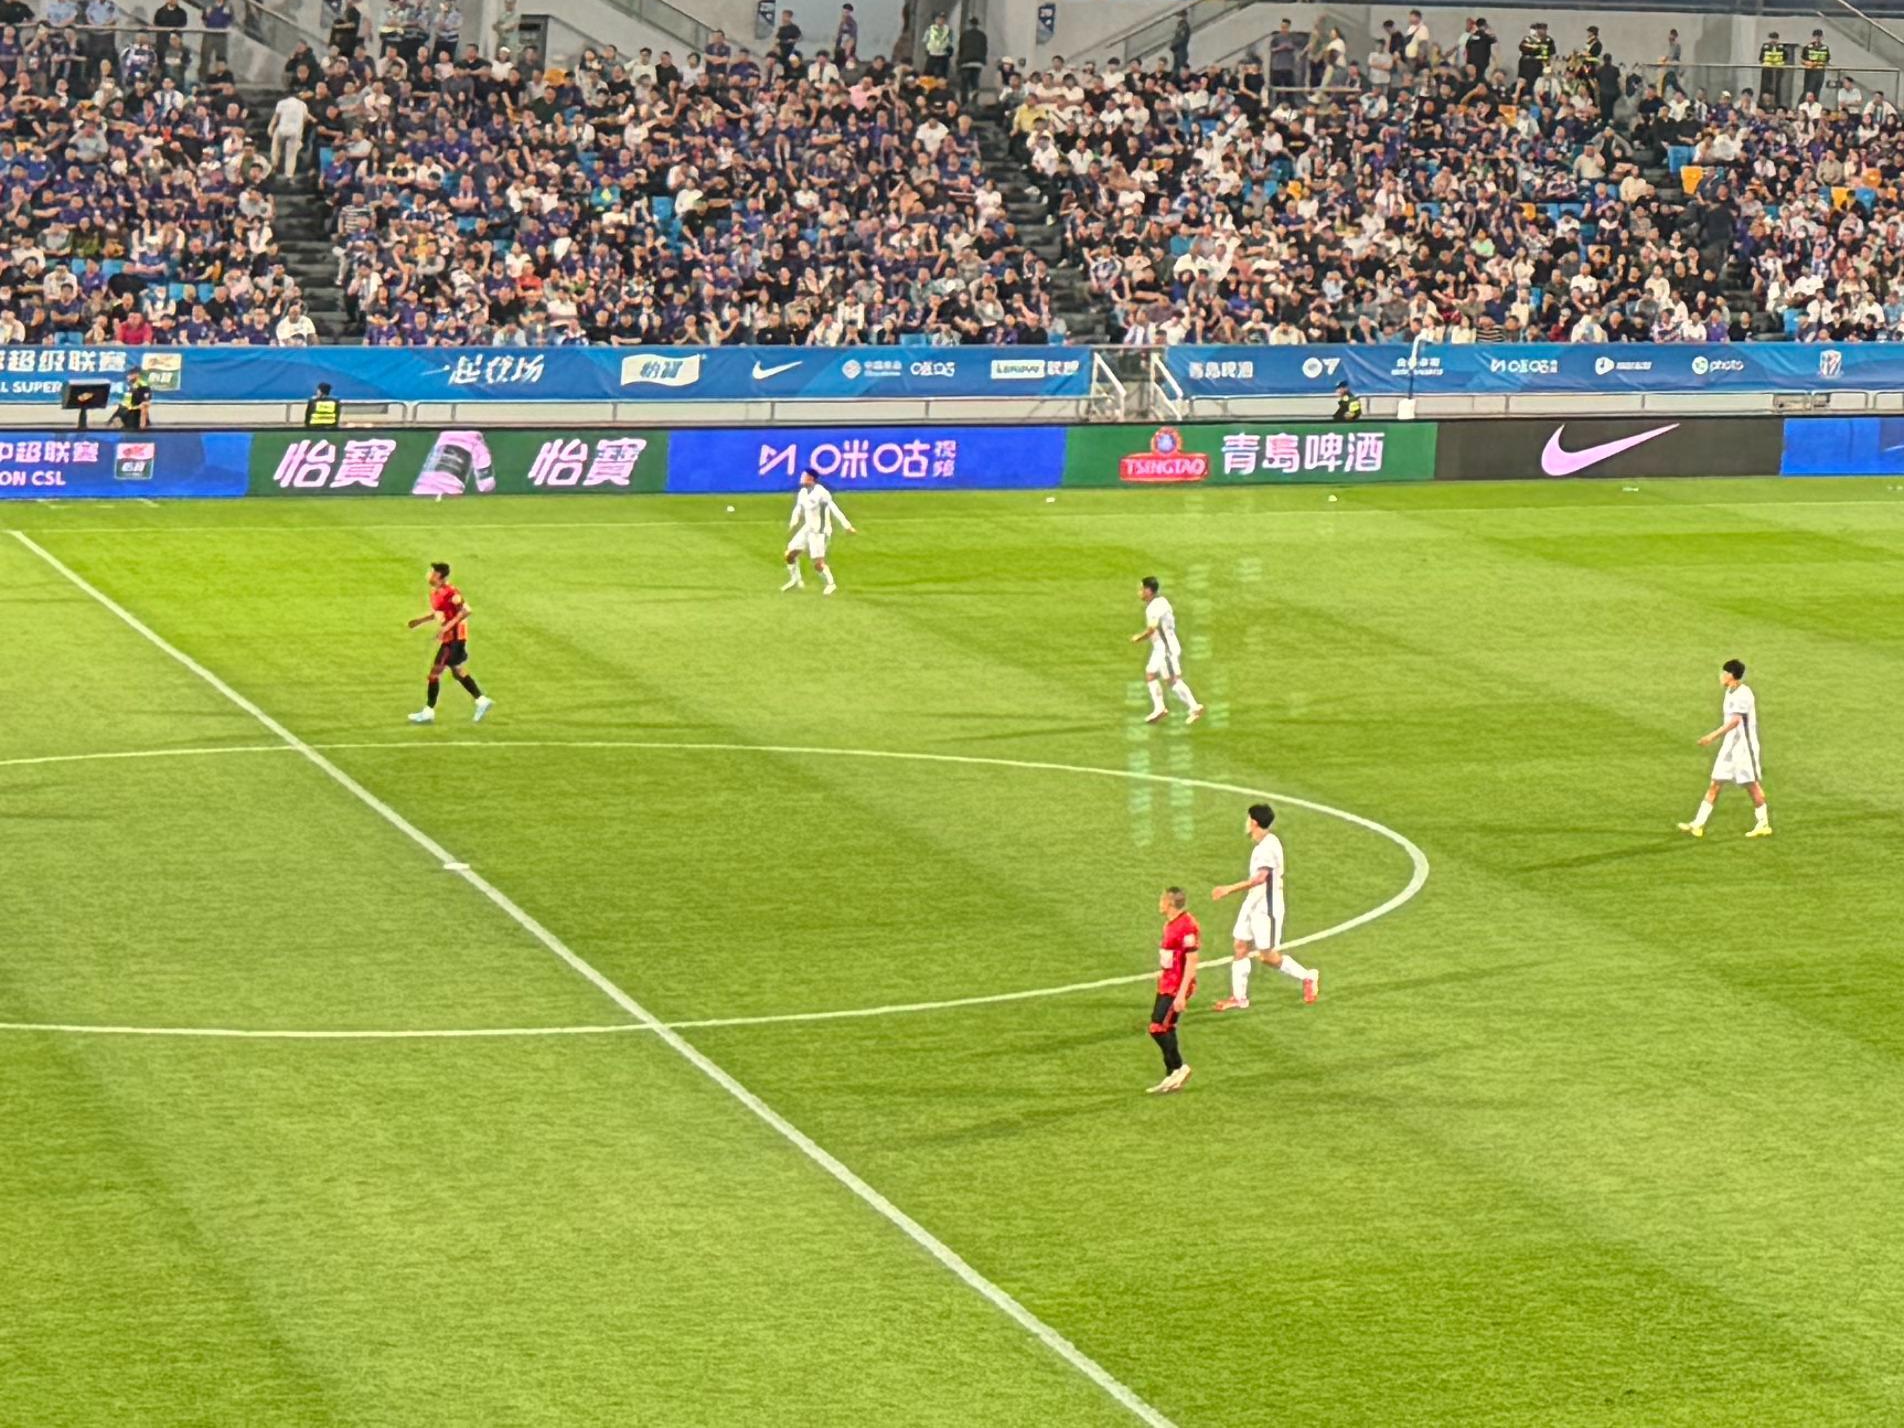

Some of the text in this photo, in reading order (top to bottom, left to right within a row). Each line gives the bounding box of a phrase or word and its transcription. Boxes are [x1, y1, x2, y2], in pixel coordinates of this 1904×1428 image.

[0, 349, 127, 373] 超级联赛
[273, 437, 397, 490] 怡寶
[528, 436, 648, 488] 怡寶
[1125, 458, 1206, 475] TSINGTAO
[31, 471, 66, 486] CSL
